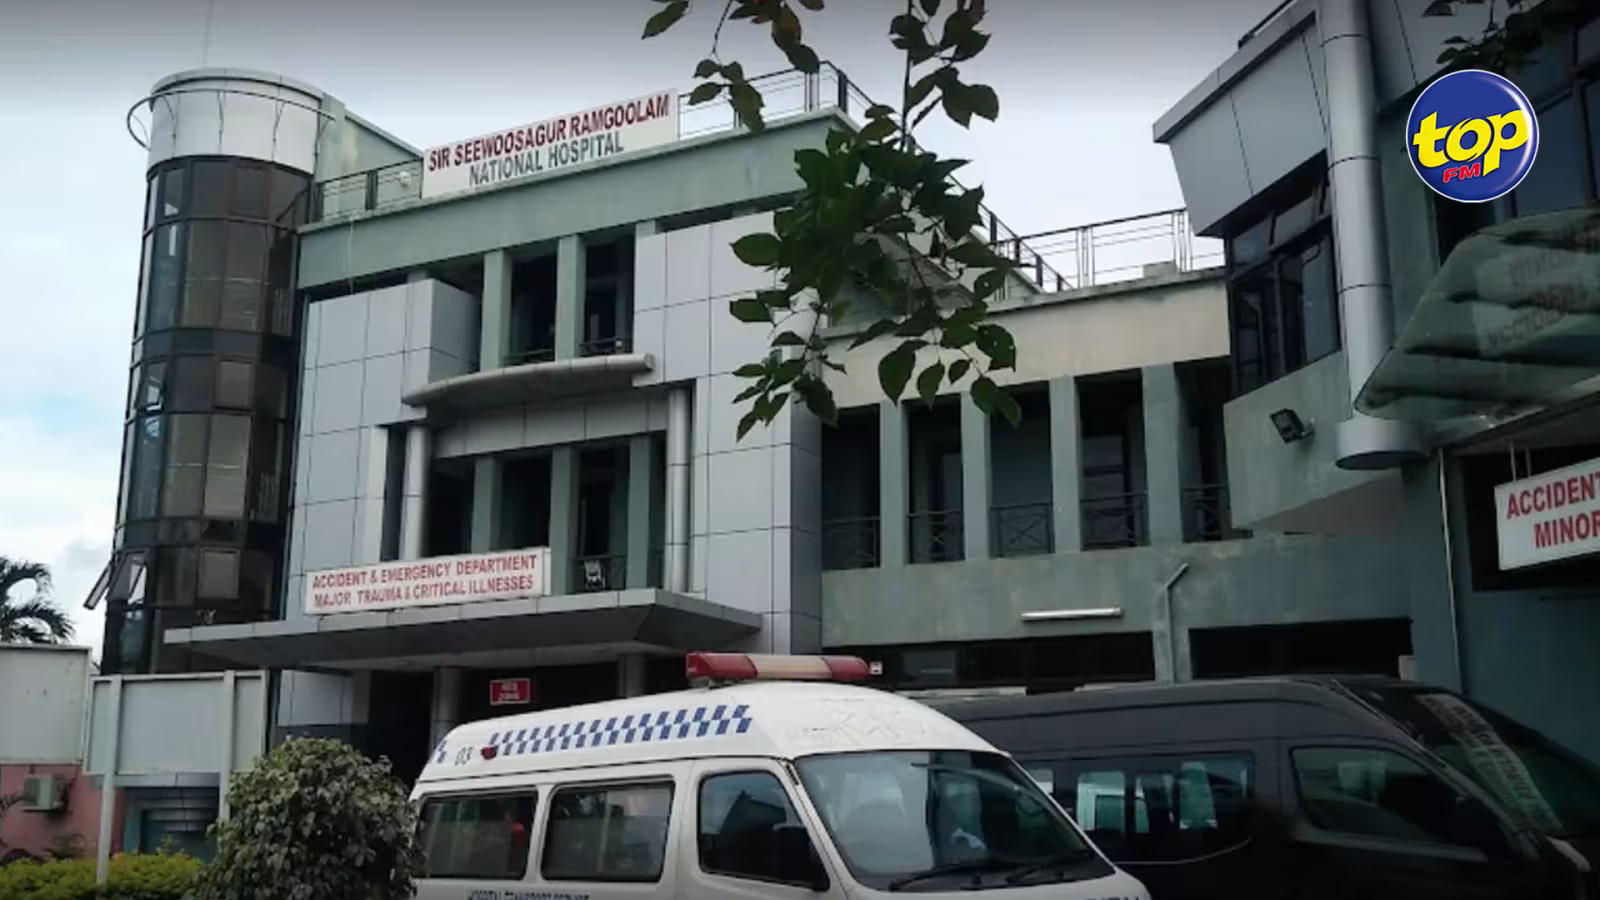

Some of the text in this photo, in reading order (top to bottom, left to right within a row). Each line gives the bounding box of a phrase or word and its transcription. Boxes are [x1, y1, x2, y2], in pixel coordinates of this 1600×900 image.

[428, 94, 670, 172] SIR SEEWOOSAGUR RAMGOOLAM
[469, 130, 624, 187] NATIONAL HOSPITAL
[313, 554, 537, 589] ACCIDENT & EMERGENCY DEPARTMENT
[314, 592, 351, 608] MAJOR
[357, 587, 402, 605] TRAUMA
[412, 581, 466, 600] CRITICAL
[469, 574, 534, 595] ILLNESSES
